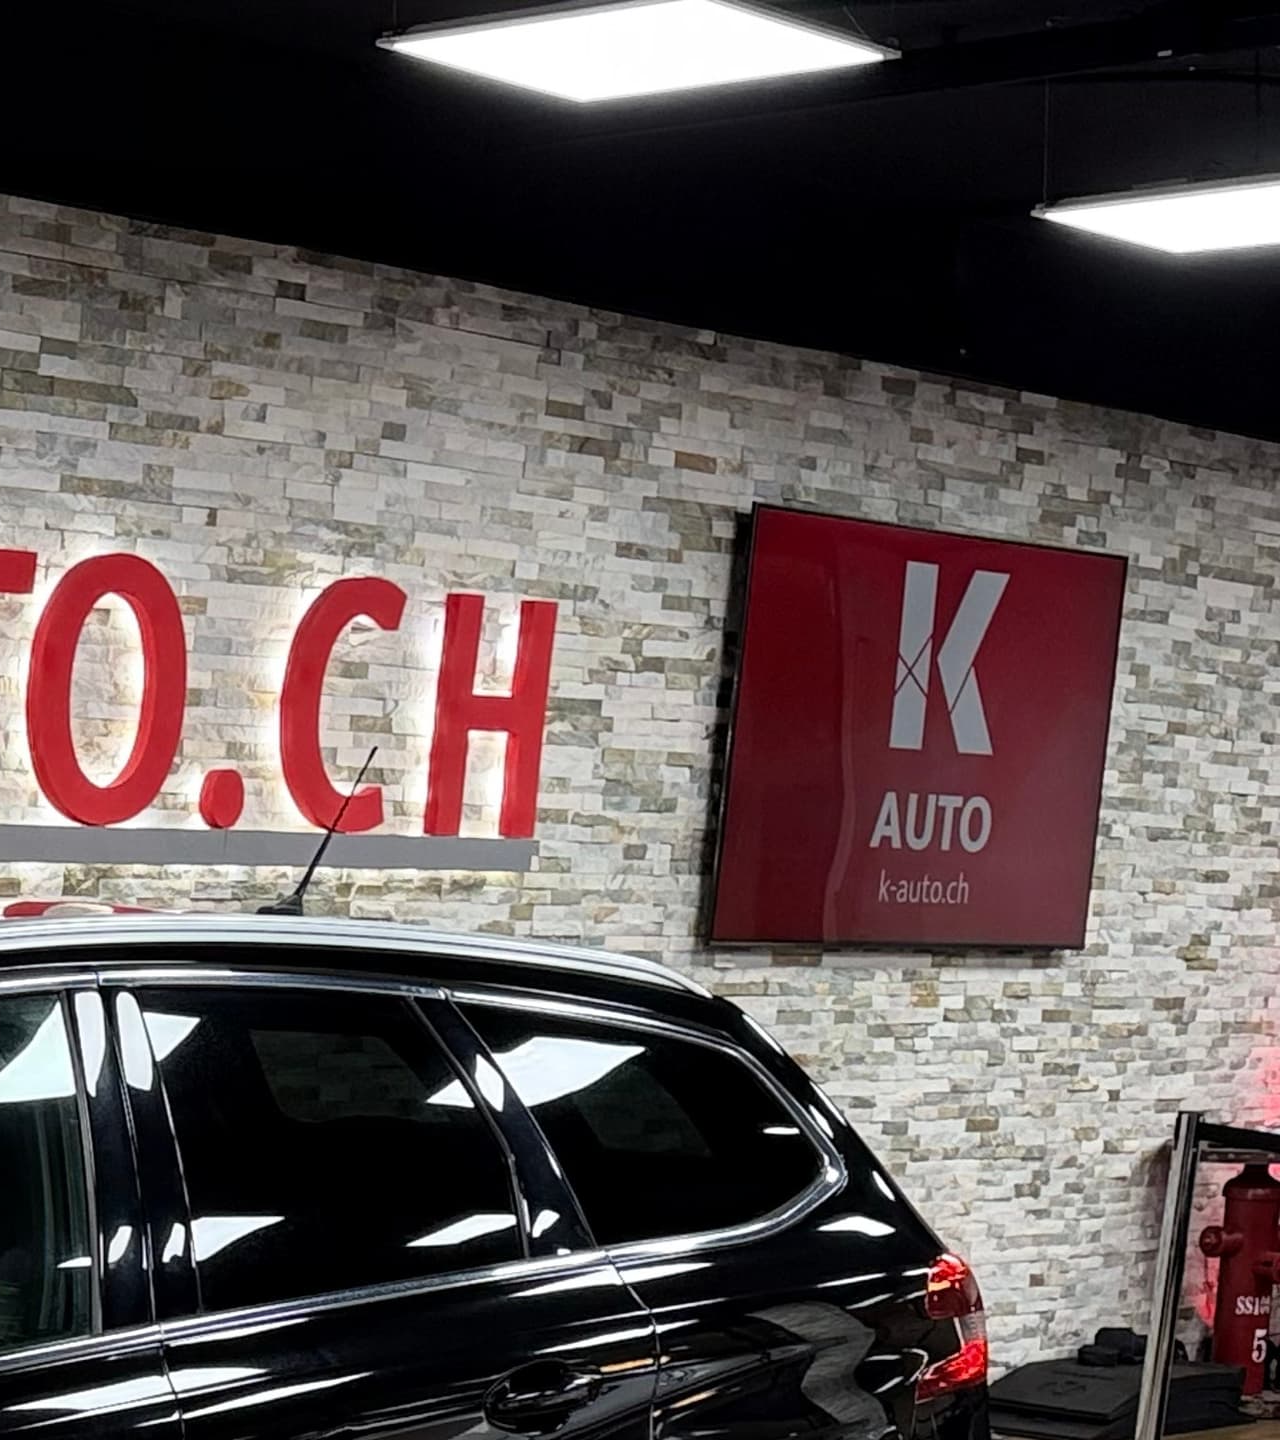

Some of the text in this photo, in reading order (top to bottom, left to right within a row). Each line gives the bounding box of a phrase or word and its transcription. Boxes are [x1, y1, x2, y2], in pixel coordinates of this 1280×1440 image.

[889, 560, 1011, 756] K
[869, 791, 992, 853] AUTO
[878, 869, 969, 904] k-auto.ch
[1251, 1328, 1268, 1363] 5
